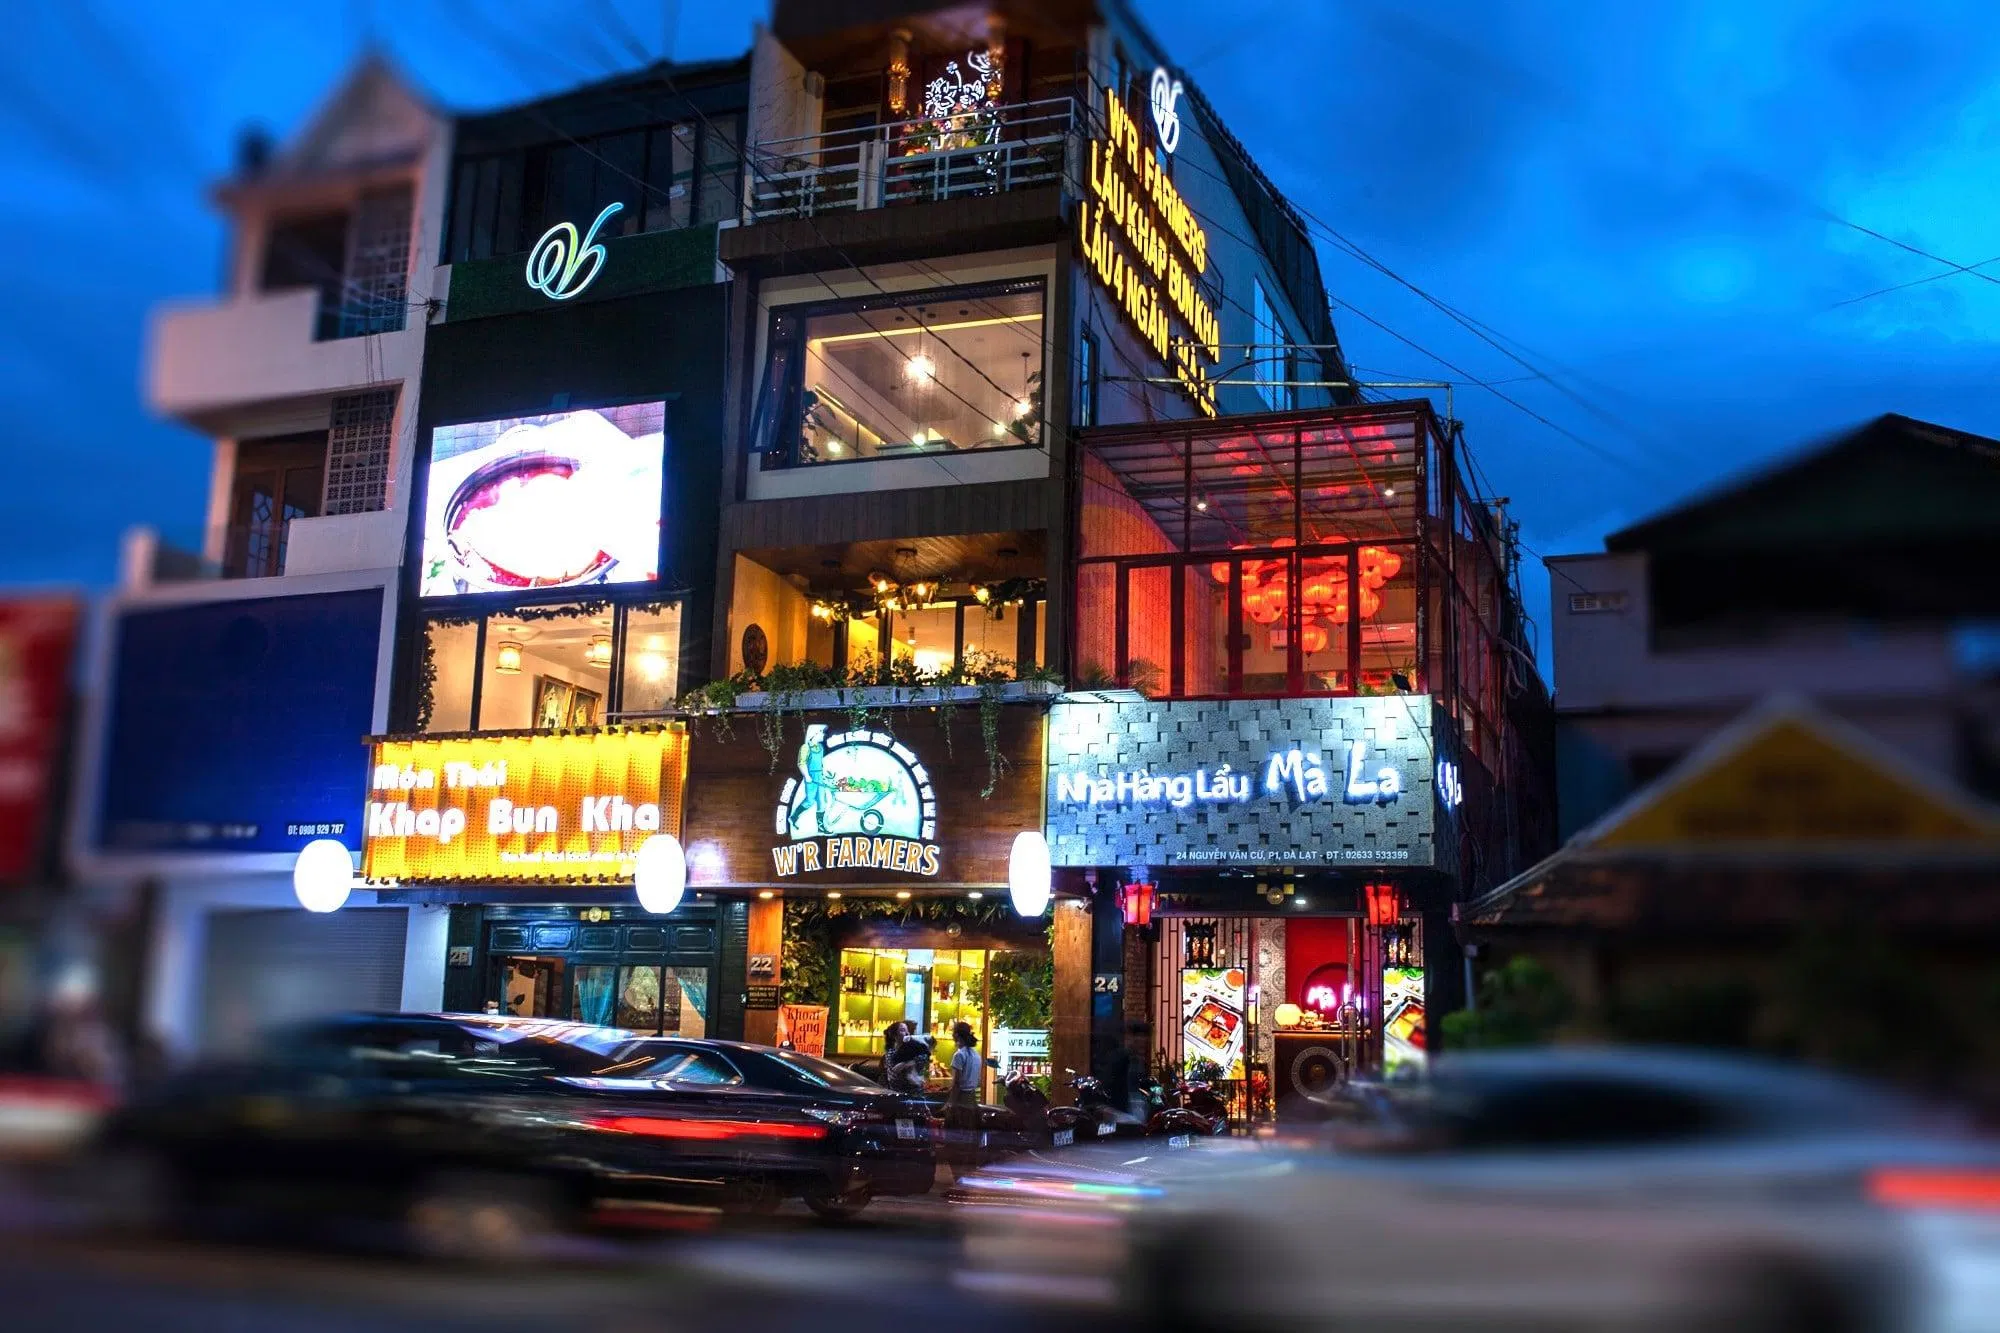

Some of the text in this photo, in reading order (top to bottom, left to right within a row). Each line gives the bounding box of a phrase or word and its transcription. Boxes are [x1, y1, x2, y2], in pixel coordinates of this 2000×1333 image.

[1108, 88, 1139, 174] W'R
[1144, 147, 1206, 274] FARMERS
[1113, 253, 1123, 300] 4
[1126, 192, 1167, 280] KHAP
[1168, 253, 1194, 326] BUN
[1194, 293, 1220, 363] KHA
[1057, 770, 1115, 804] Nhà
[1117, 768, 1191, 807] Hàng
[1196, 763, 1249, 800] Lẩu
[1266, 749, 1328, 802] Mà
[1347, 740, 1399, 796] La
[368, 795, 660, 844] Khap Bun Kha
[773, 837, 940, 877] W'R FARMERS
[1176, 851, 1187, 860] 24
[1345, 850, 1373, 860] 02633
[1375, 850, 1408, 861] 533399
[750, 956, 772, 973] 22
[1094, 976, 1119, 993] 24
